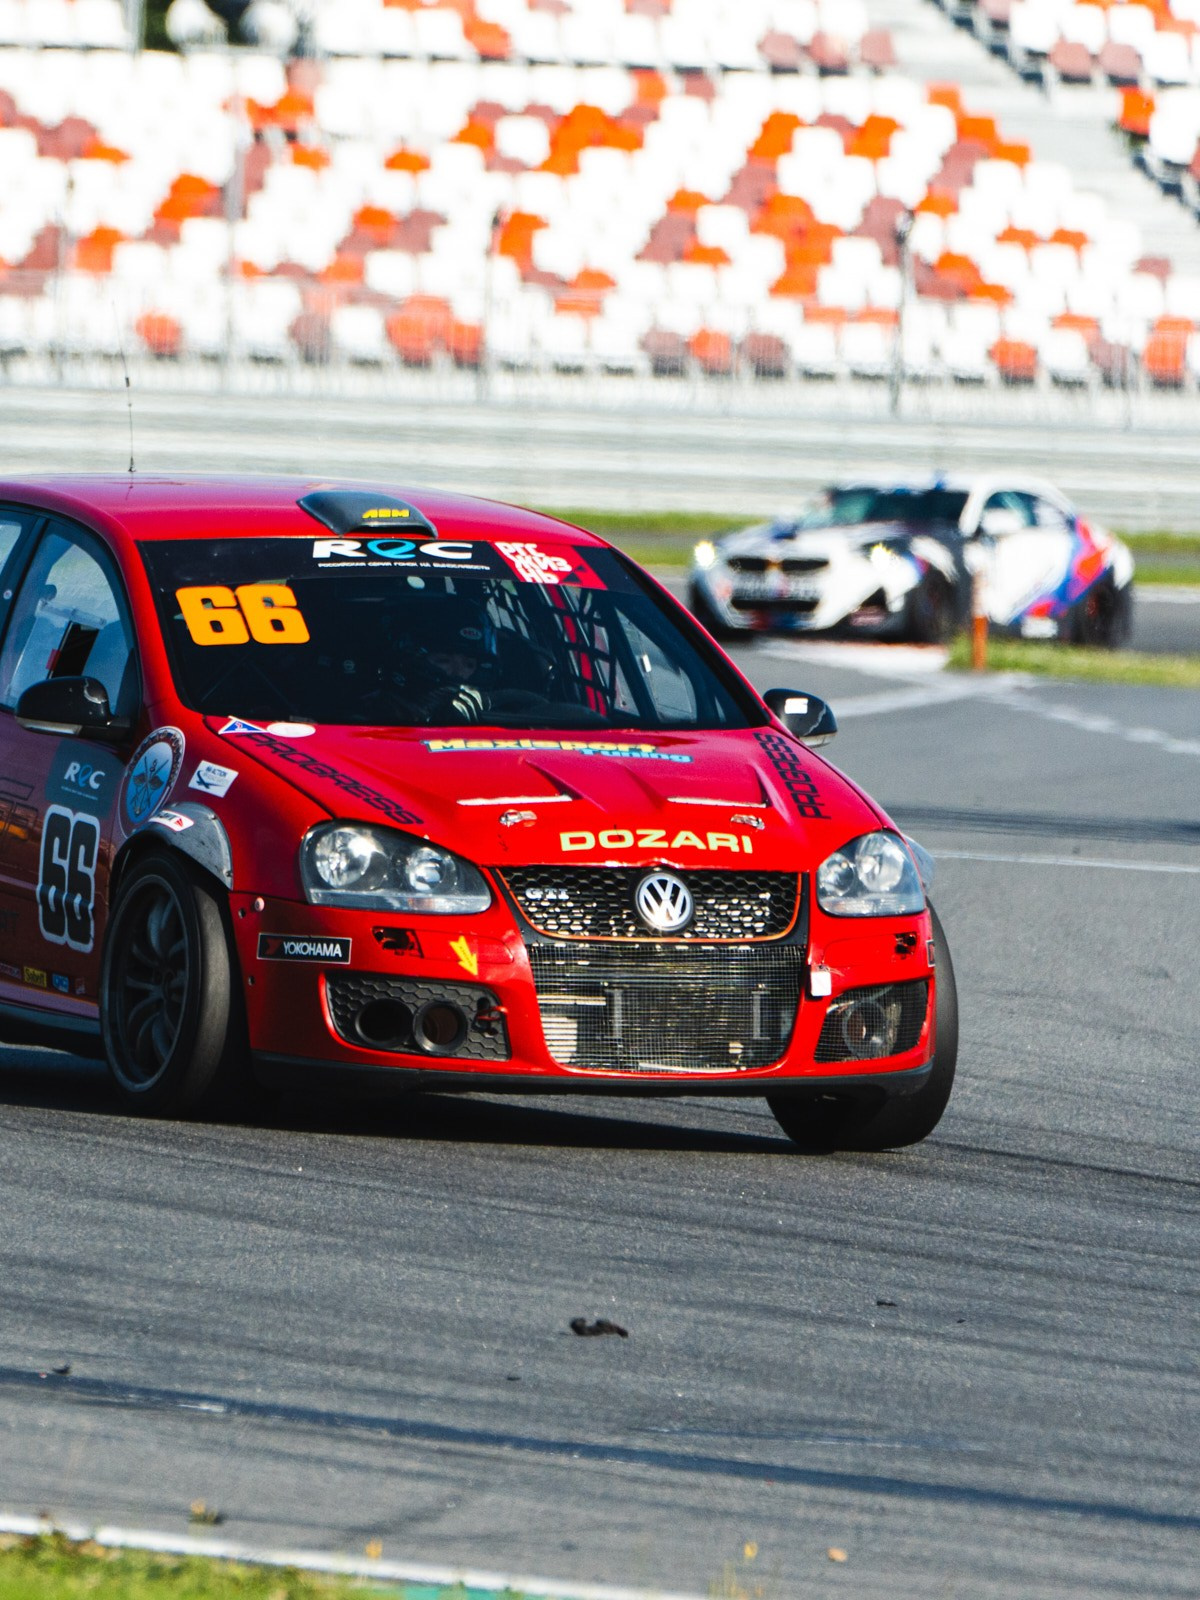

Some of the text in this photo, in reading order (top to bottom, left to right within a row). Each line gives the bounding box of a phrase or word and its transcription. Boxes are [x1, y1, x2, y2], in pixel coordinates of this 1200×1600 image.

[175, 584, 310, 646] 66
[235, 732, 425, 825] PROGRESS
[752, 732, 832, 820] PROGRESS
[559, 829, 754, 854] DOZARI
[40, 806, 99, 952] 66
[525, 887, 570, 901] GTI
[282, 941, 343, 958] YOKOHAMA
